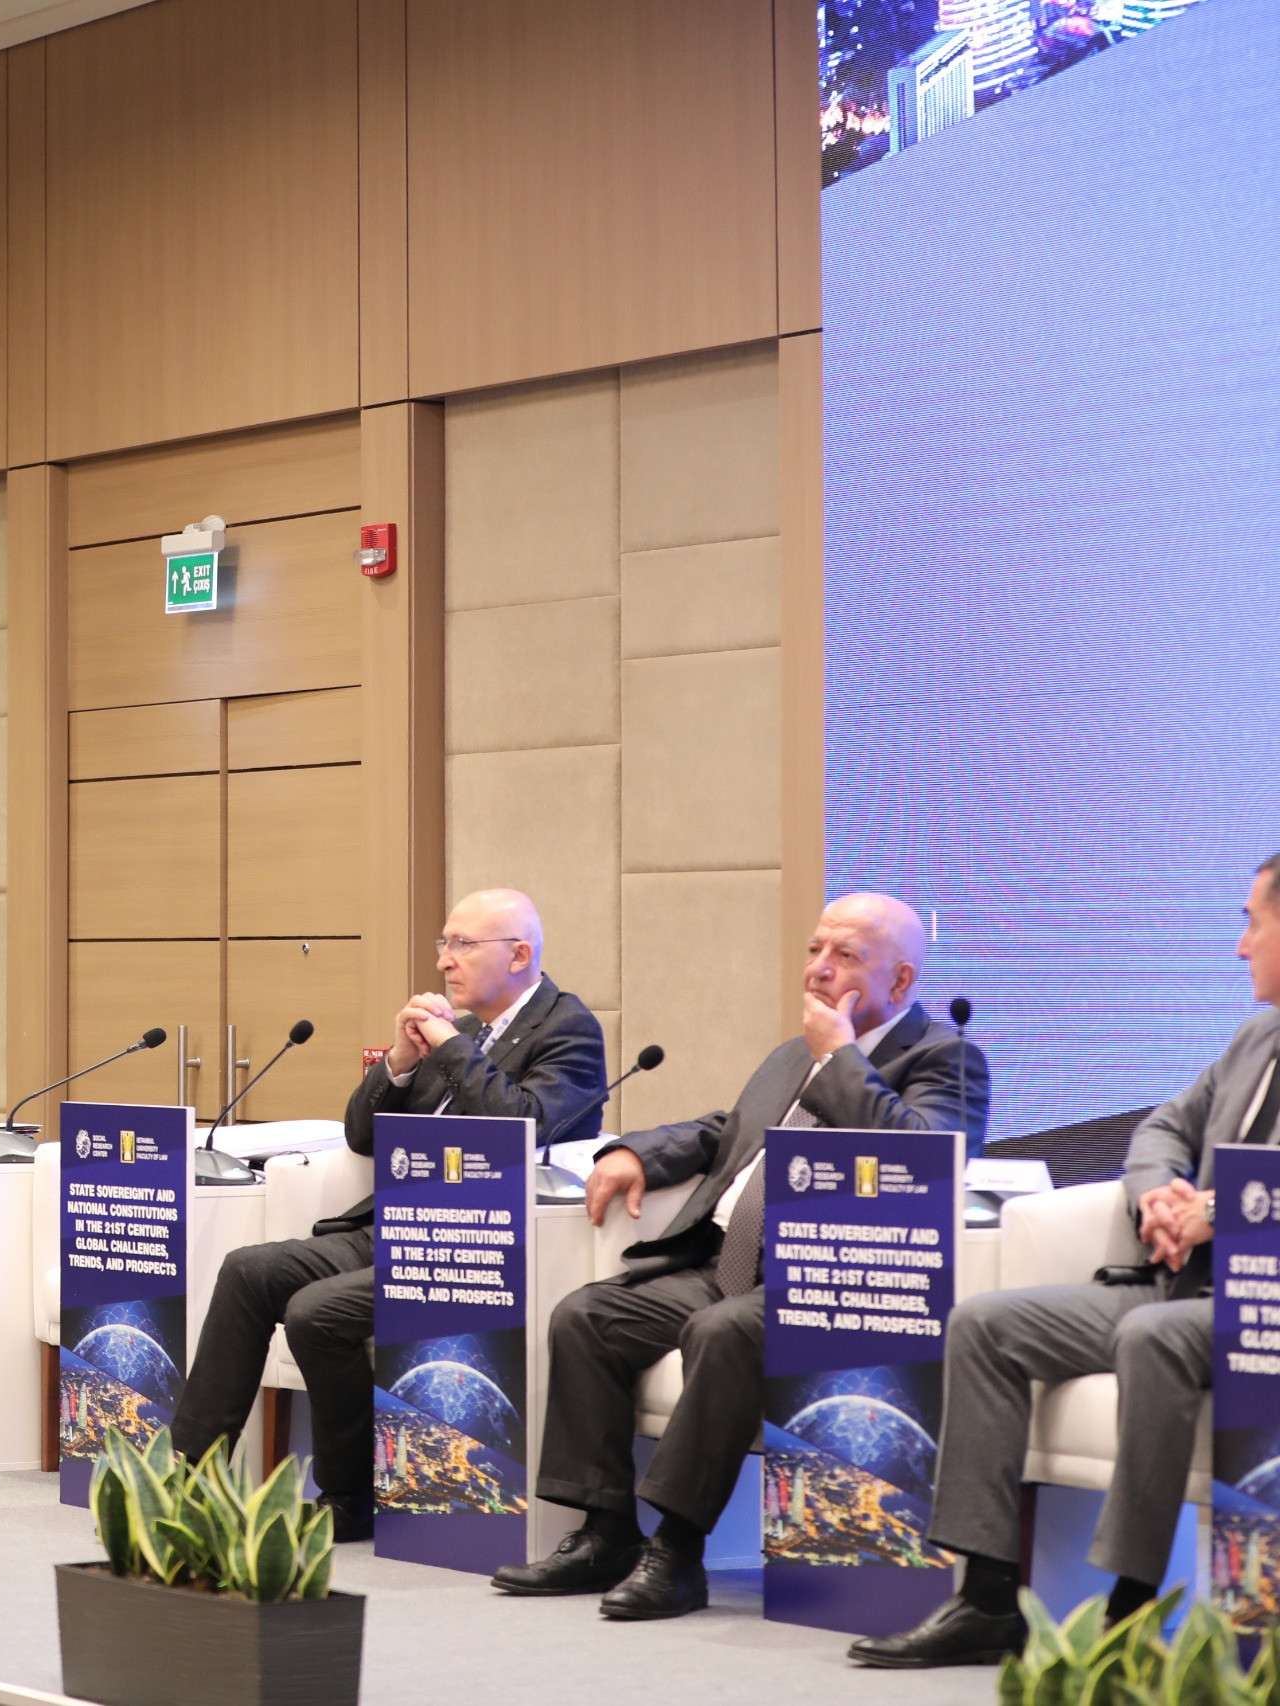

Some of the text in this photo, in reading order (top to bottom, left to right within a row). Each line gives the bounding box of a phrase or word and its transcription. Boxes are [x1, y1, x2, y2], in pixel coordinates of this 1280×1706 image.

[194, 564, 210, 578] EXIT
[364, 566, 378, 574] FIRE
[193, 578, 210, 594] ÇIXIŞ
[70, 1183, 175, 1202] STATE SOVEREIGNTY AND
[68, 1201, 178, 1221] NATIONAL CONSTITUTIONS
[384, 1206, 511, 1225] STATE SOVEREIGNTY AND
[76, 1219, 169, 1238] IN THE 21ST CENTURY:
[381, 1226, 514, 1245] NATIONAL CONSTITUTIONS
[778, 1222, 939, 1246] STATE SOVEREIGNTY AND
[76, 1237, 168, 1259] GLOBAL CHALLENGES,
[391, 1246, 504, 1265] IN THE 21ST CENTURY:
[775, 1243, 943, 1269] NATIONAL CONSTITUTIONS
[69, 1254, 177, 1276] TRENDS, AND PROSPECTS
[391, 1266, 504, 1288] GLOBAL CHALLENGES,
[787, 1266, 930, 1290] IN THE 21ST CENTURY:
[383, 1285, 514, 1306] TRENDS, AND PROSPECTS
[788, 1288, 929, 1316] GLOBAL CHALLENGES,
[777, 1308, 942, 1337] TRENDS, AND PROSPECTS
[1260, 1305, 1280, 1325] TH
